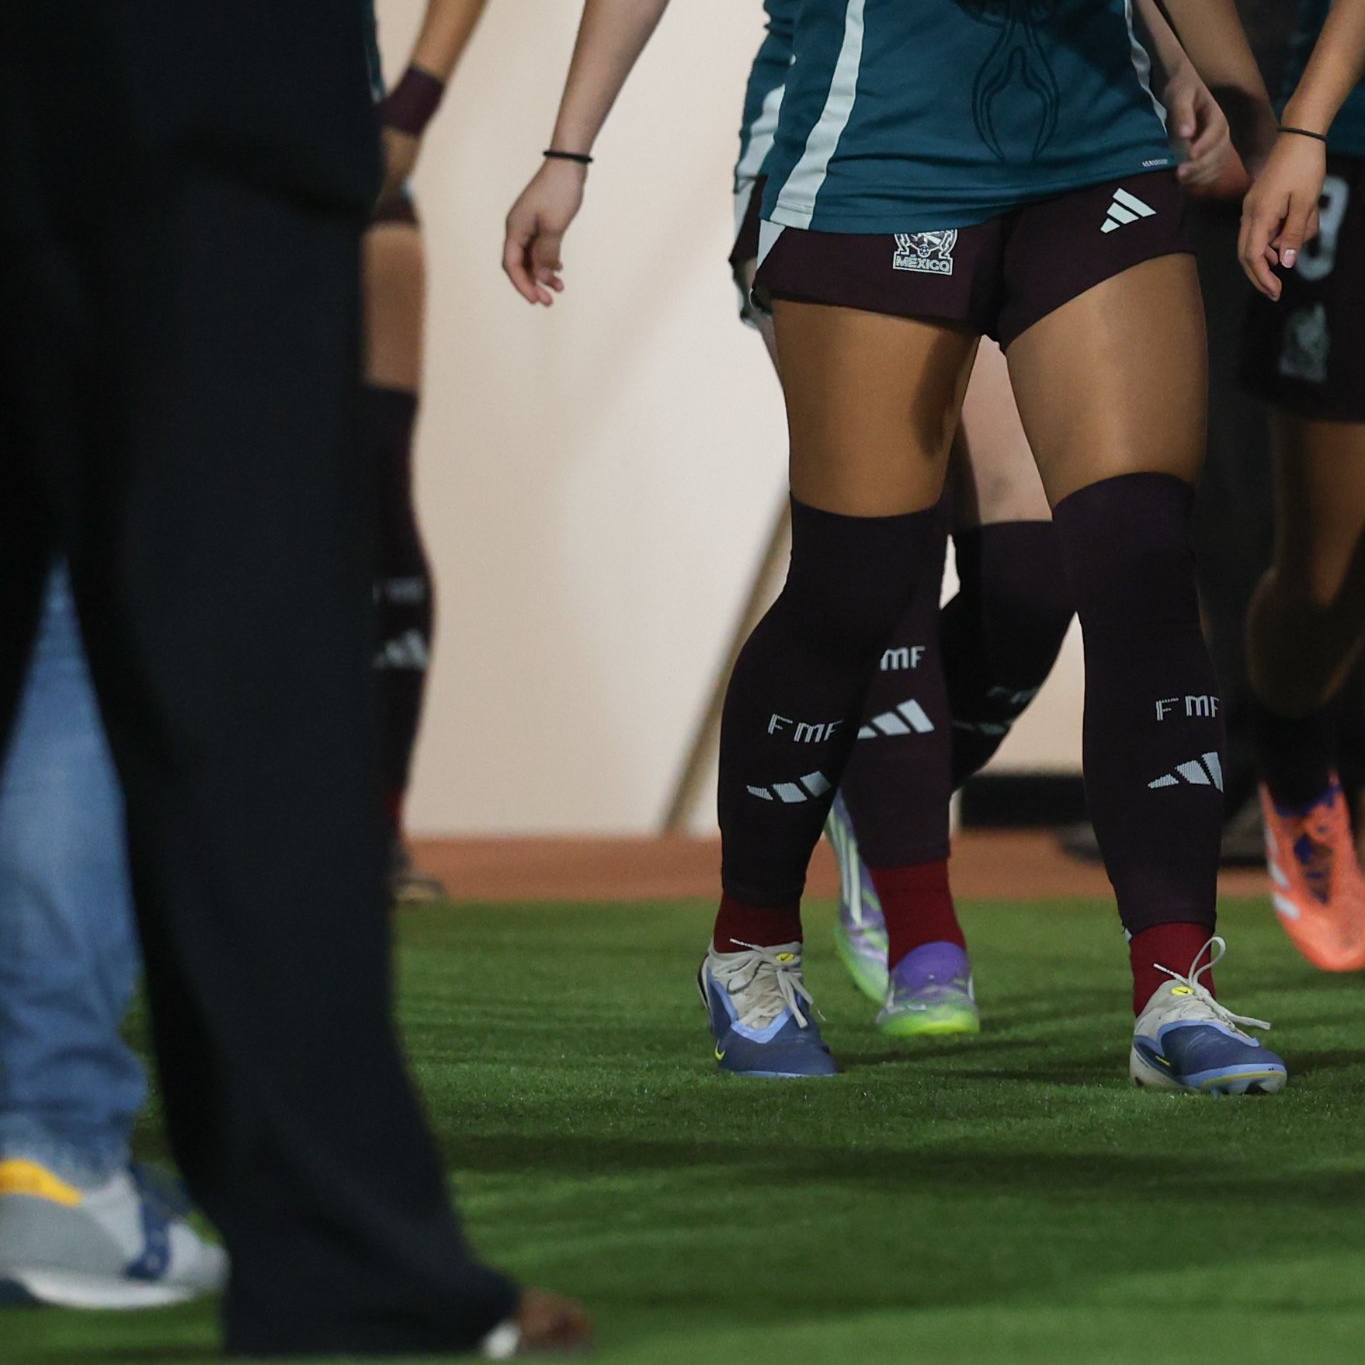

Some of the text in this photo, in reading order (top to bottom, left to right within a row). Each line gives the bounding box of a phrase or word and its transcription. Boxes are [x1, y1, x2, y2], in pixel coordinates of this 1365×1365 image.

[880, 646, 925, 671] MF
[1156, 695, 1220, 722] FMF
[768, 713, 844, 744] FMF
